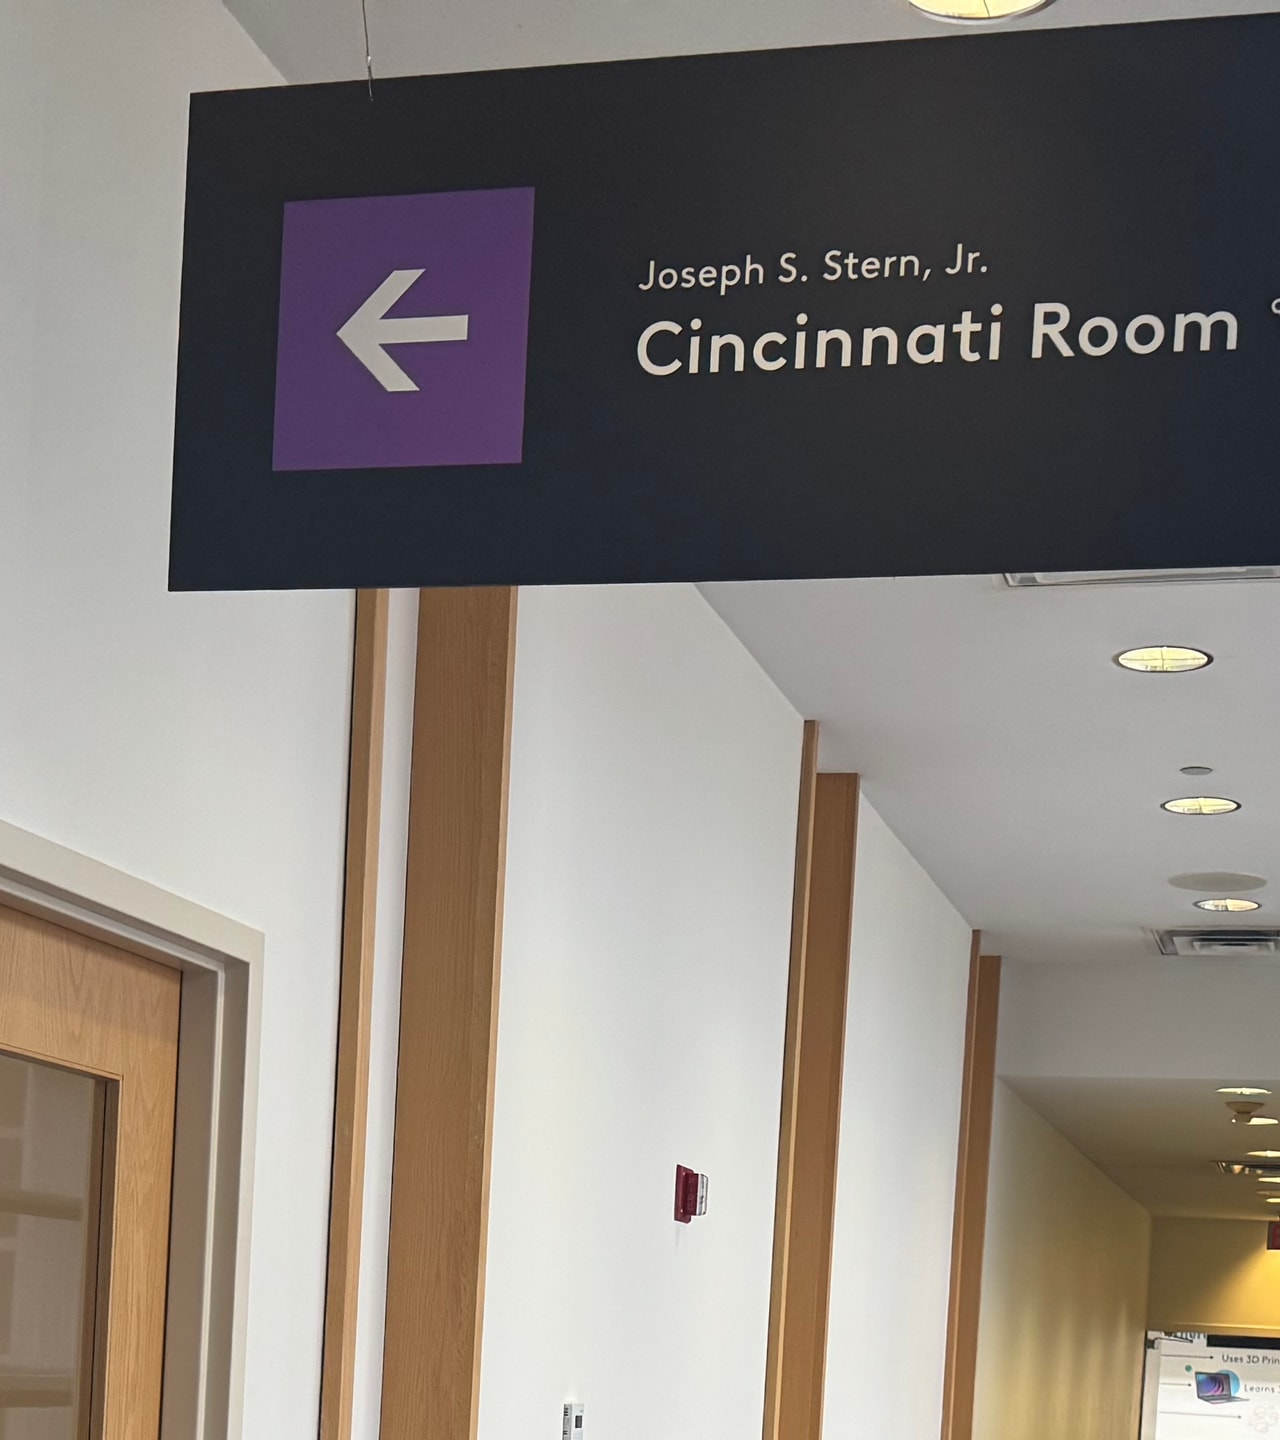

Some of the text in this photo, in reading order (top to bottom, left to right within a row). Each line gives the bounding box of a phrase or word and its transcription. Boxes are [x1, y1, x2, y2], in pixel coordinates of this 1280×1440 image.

[638, 242, 990, 296] Joseph S. Stern, Jr.
[636, 300, 1240, 377] Cincinnati Room
[1221, 1353, 1244, 1364] Uses
[1246, 1354, 1260, 1364] 3D
[1244, 1384, 1275, 1393] Learns
